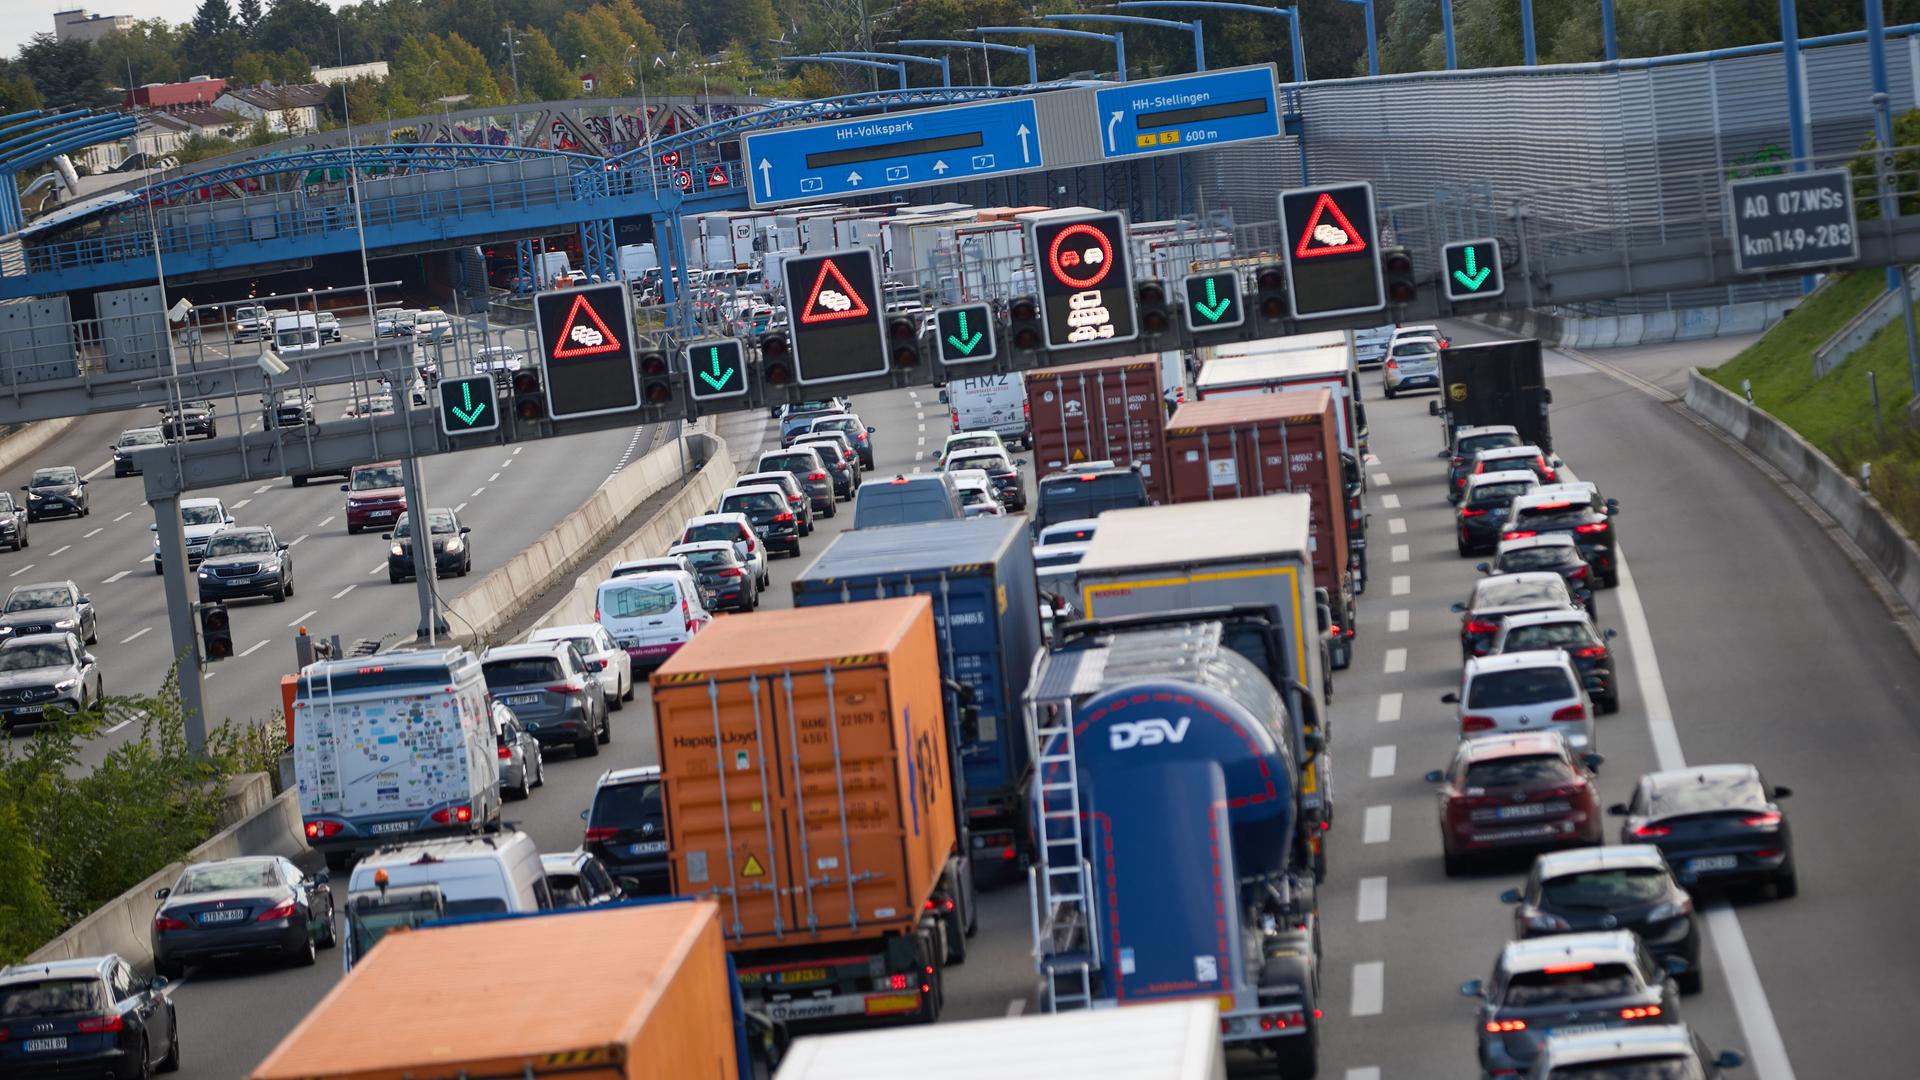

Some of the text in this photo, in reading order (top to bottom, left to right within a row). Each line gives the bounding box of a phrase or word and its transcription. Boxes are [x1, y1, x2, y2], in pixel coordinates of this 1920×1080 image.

[1132, 92, 1210, 110] HH-Stellingen
[836, 121, 914, 140] HH-Volkspark
[1186, 130, 1206, 142] 600
[1207, 130, 1218, 139] m
[1744, 195, 1770, 219] AQ
[964, 375, 1008, 390] HMZ
[673, 730, 758, 749] HapagLloyd
[1109, 716, 1191, 751] DSV
